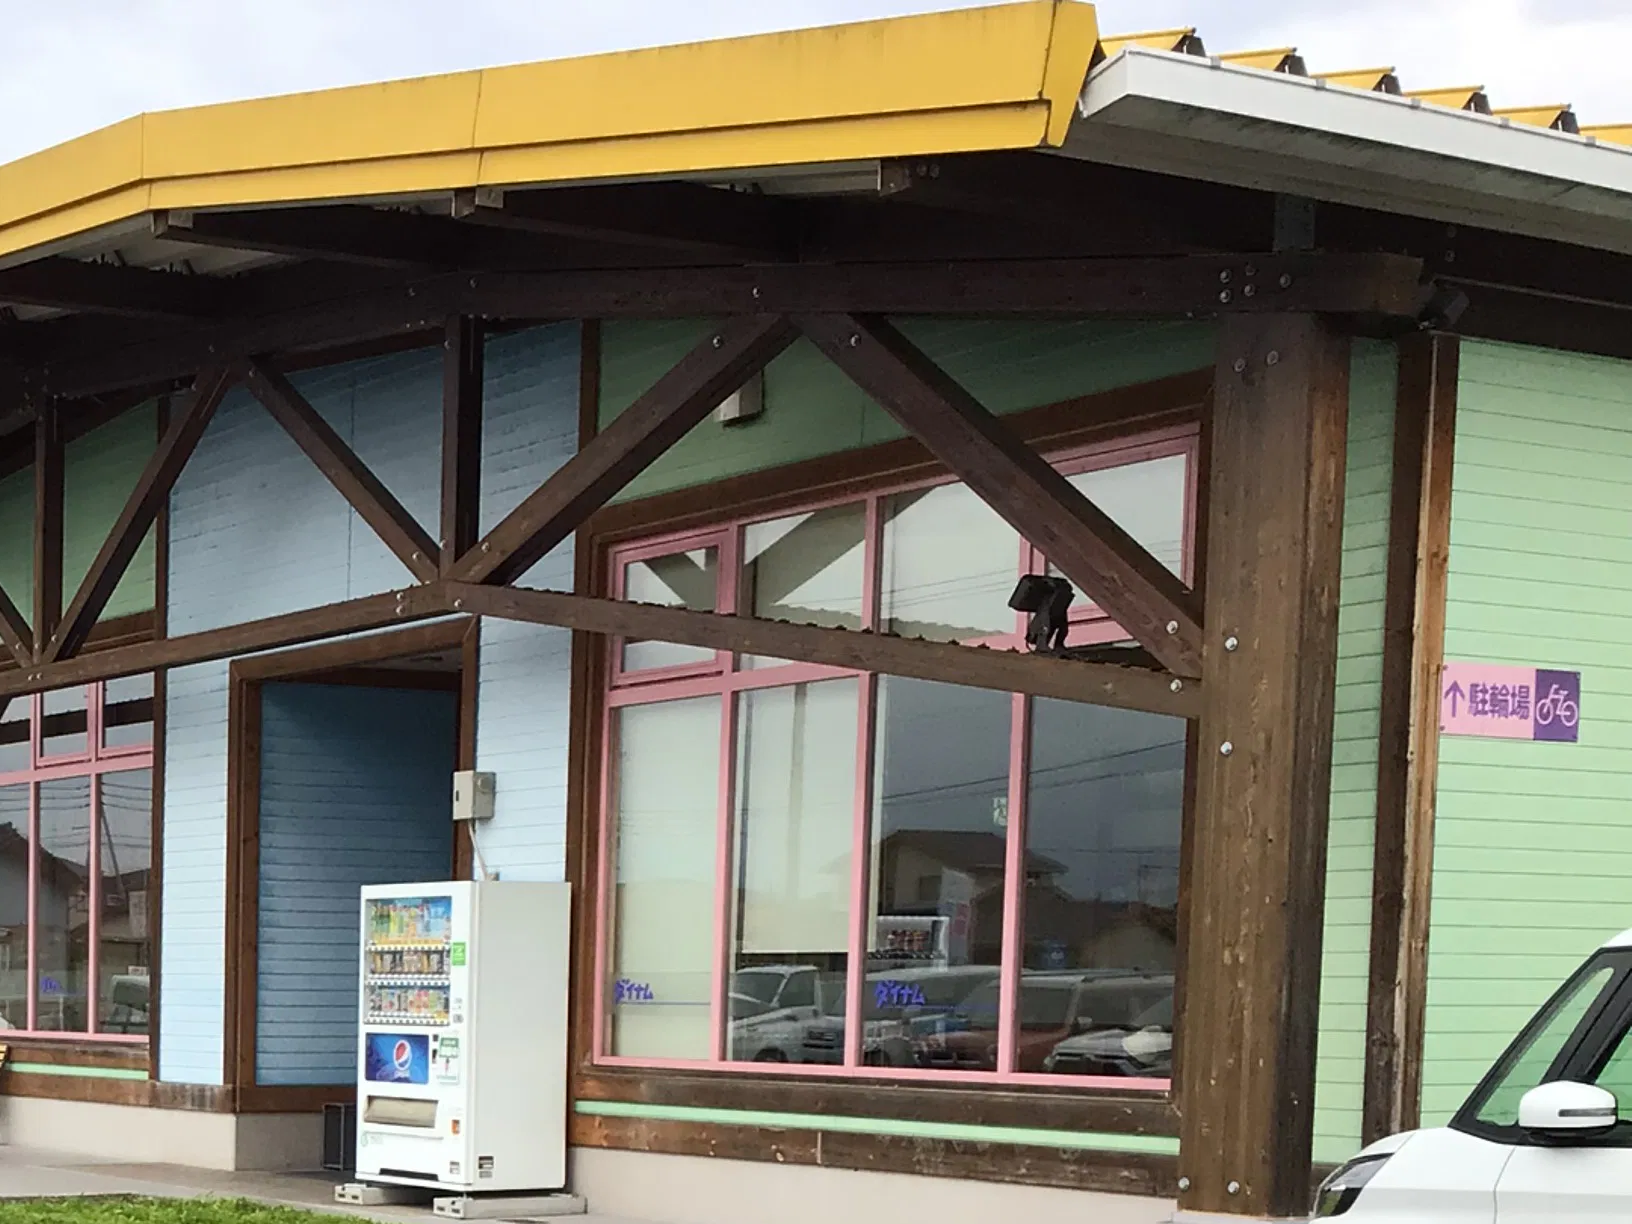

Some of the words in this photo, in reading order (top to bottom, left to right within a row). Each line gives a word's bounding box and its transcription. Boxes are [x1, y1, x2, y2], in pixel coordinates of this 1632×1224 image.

[1468, 682, 1530, 719] 駐輪場
[874, 979, 925, 1008] ダイナム
